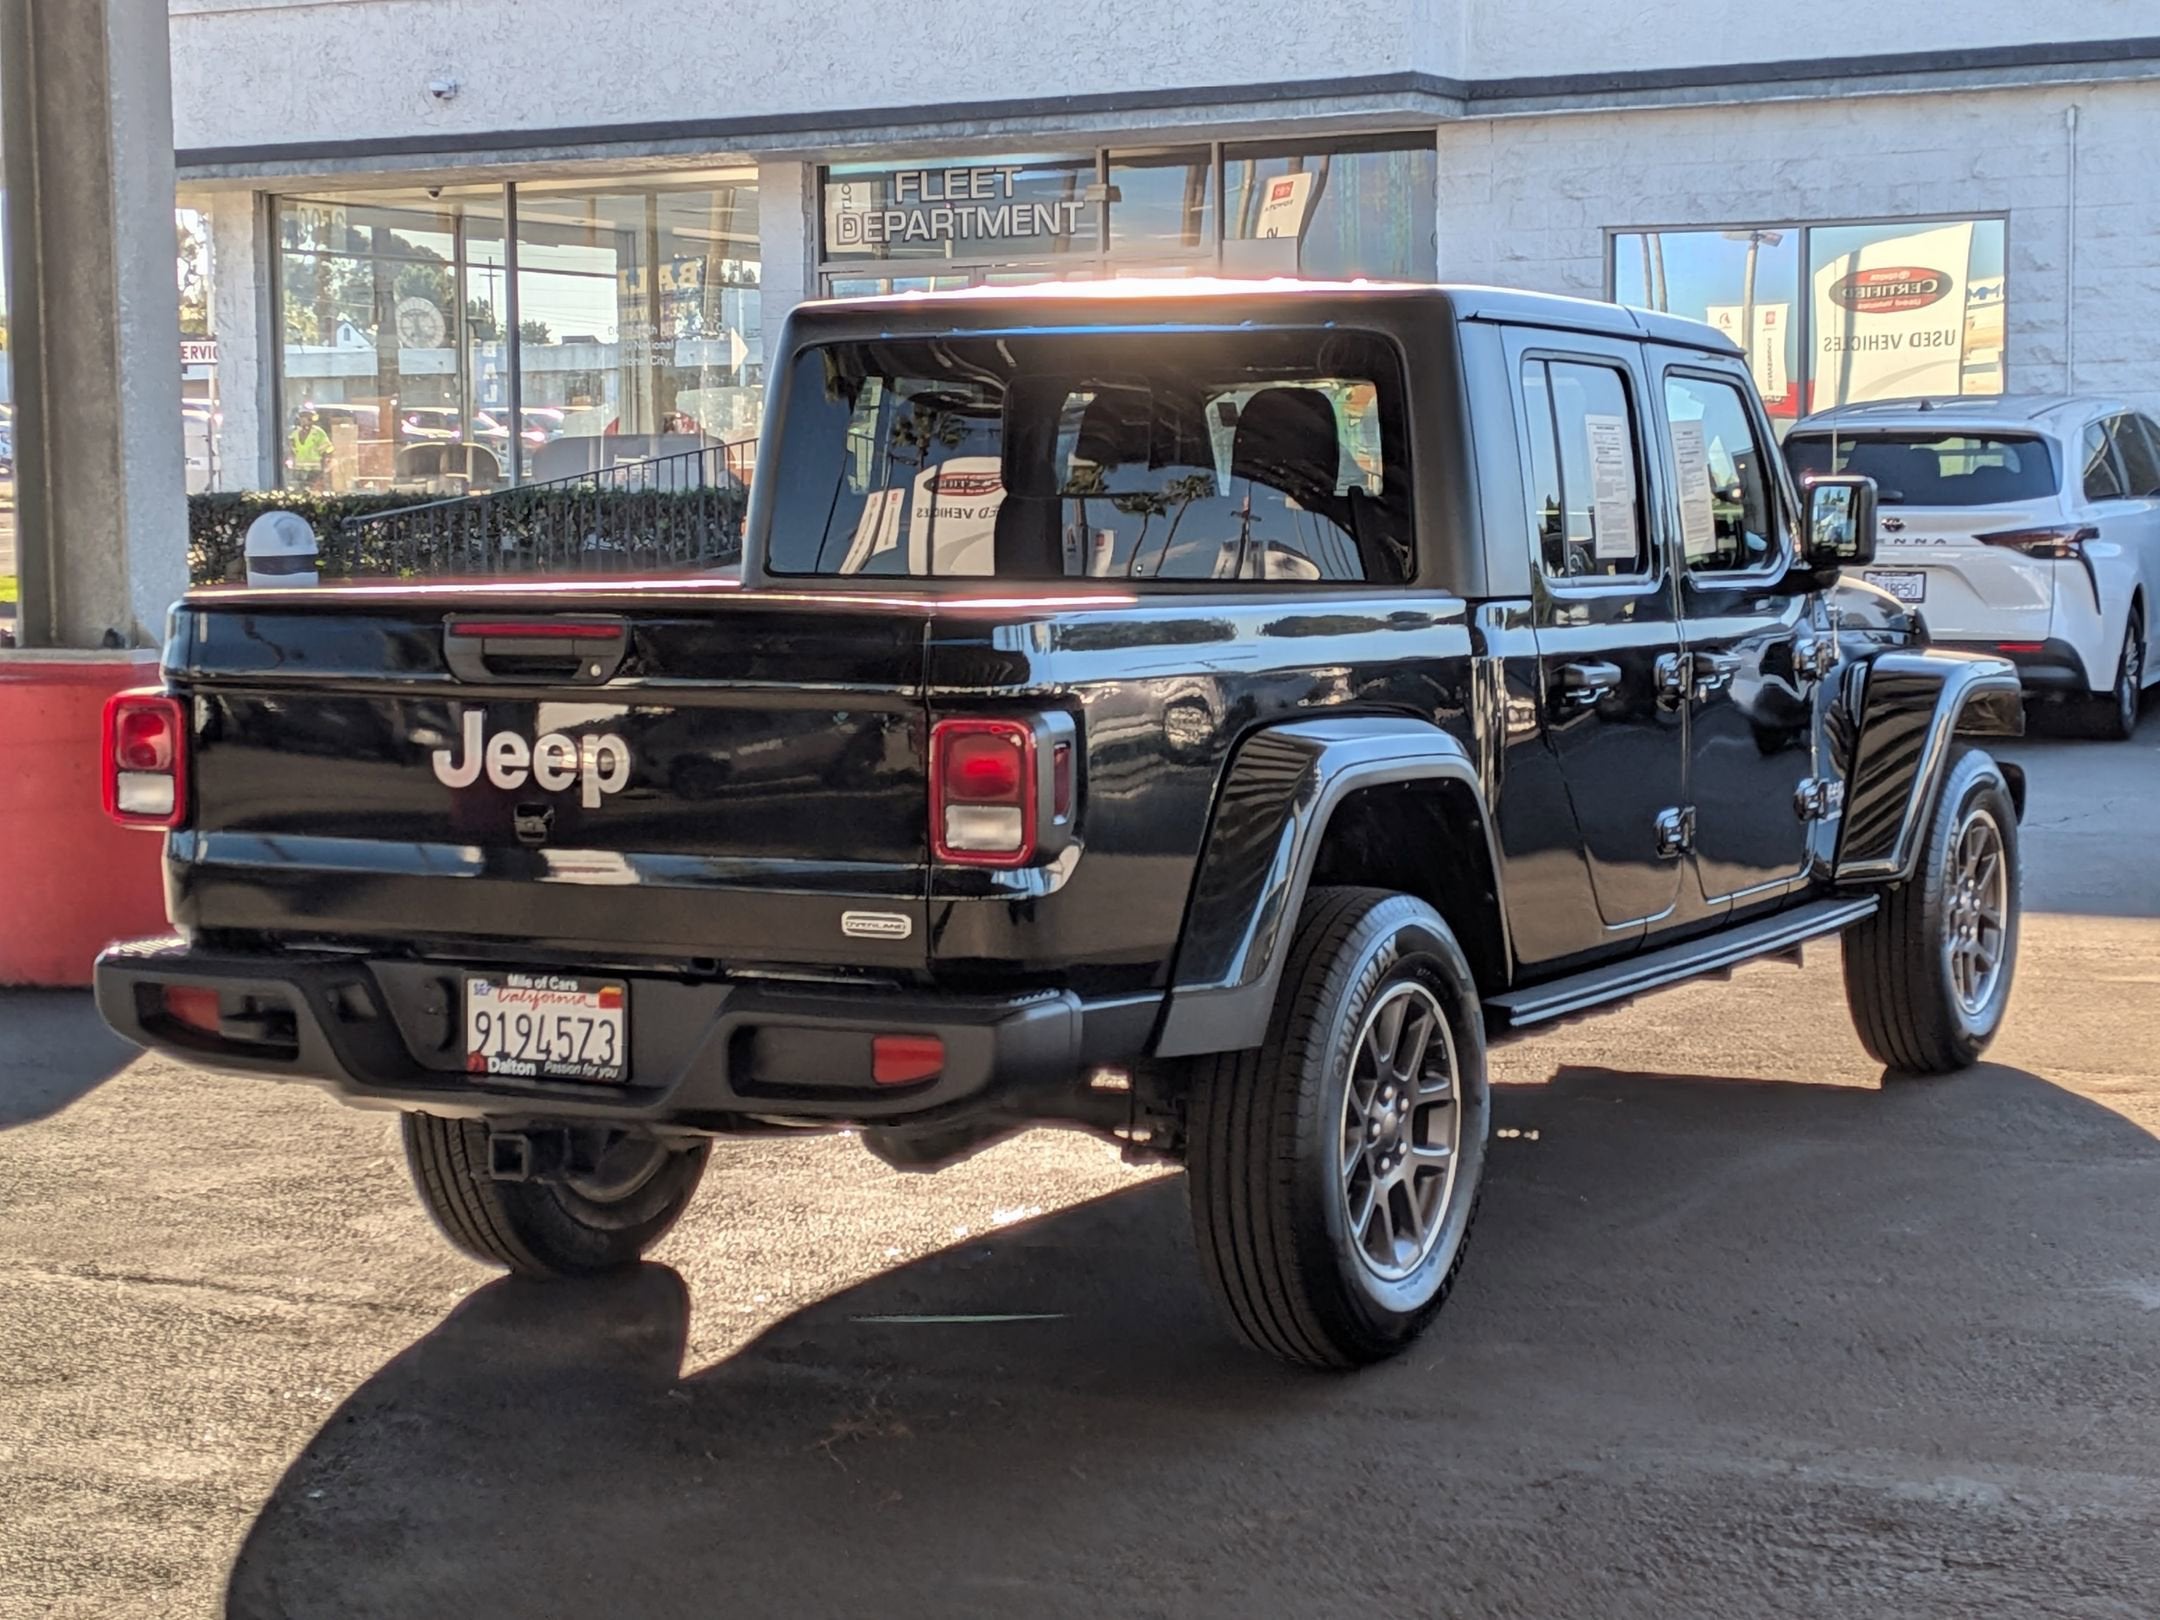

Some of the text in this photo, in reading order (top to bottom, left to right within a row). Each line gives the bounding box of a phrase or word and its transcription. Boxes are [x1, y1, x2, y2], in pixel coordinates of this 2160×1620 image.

[894, 166, 1023, 204] FLEET
[836, 201, 1084, 245] DEPARTMENT
[432, 710, 631, 808] Jeep
[507, 973, 533, 988] Mile
[534, 975, 548, 989] of
[549, 976, 578, 991] Cars
[487, 1056, 537, 1076] Dalton
